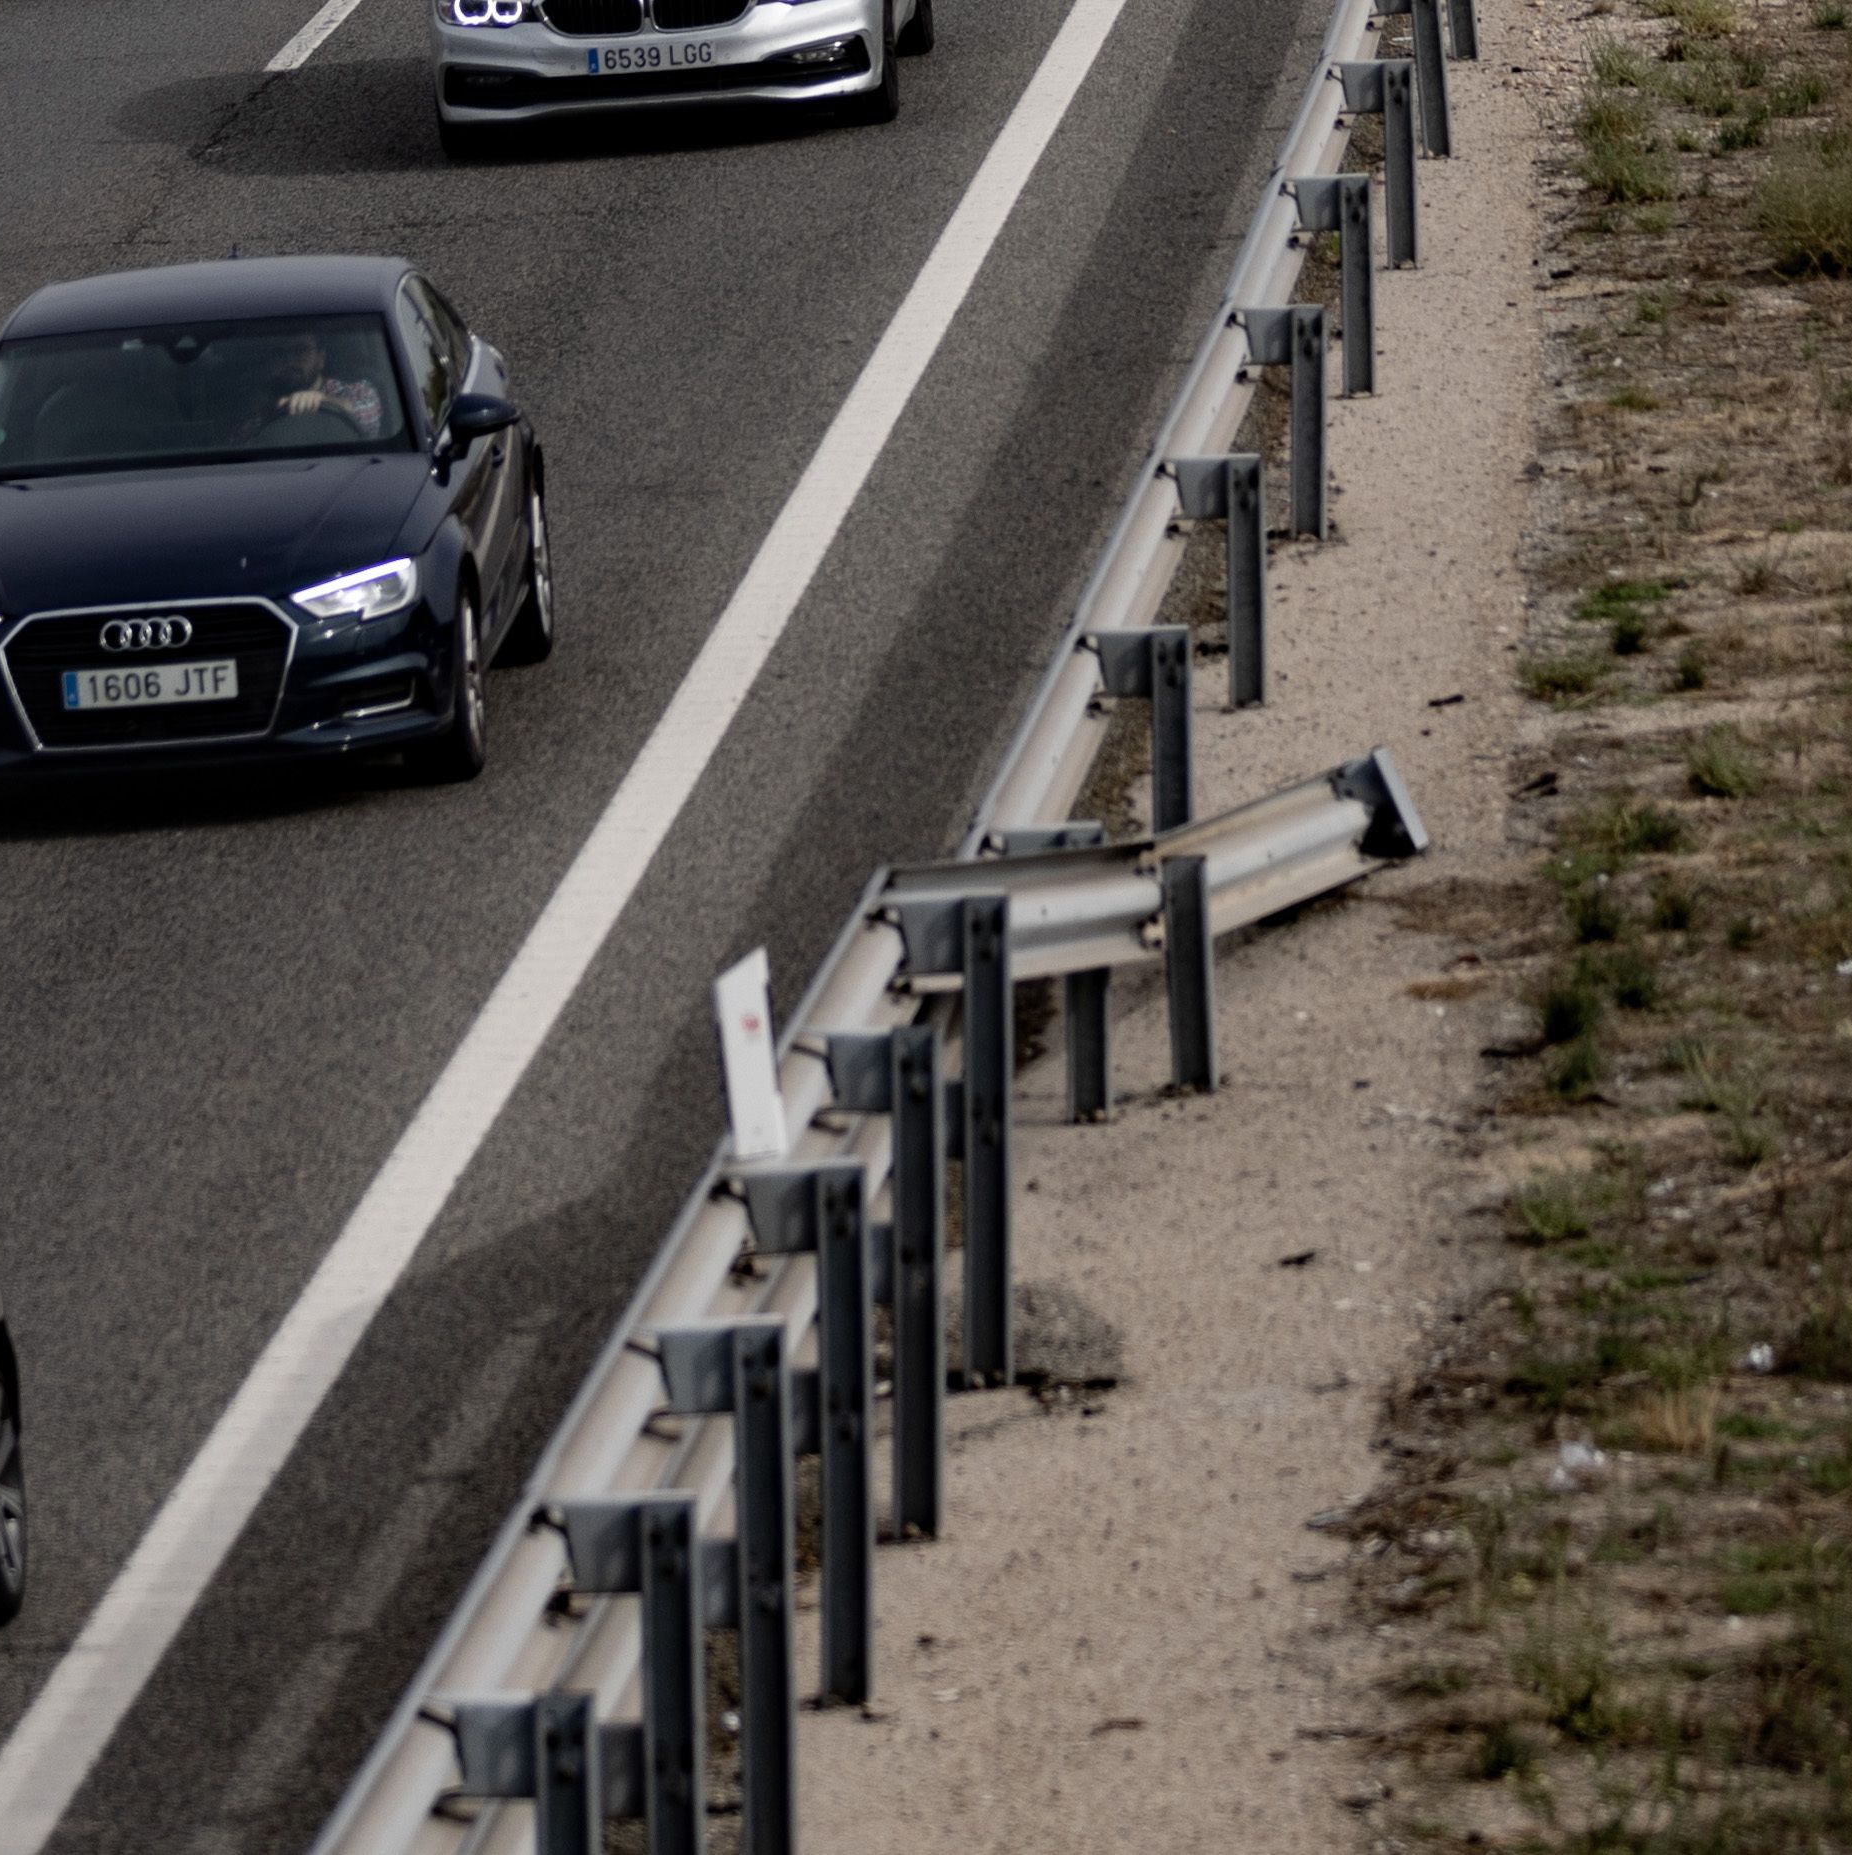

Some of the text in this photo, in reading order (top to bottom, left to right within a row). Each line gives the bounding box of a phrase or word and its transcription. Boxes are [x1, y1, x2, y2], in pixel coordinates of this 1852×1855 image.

[604, 42, 712, 70] 6539 LGG
[88, 665, 229, 704] 1606 JTF
